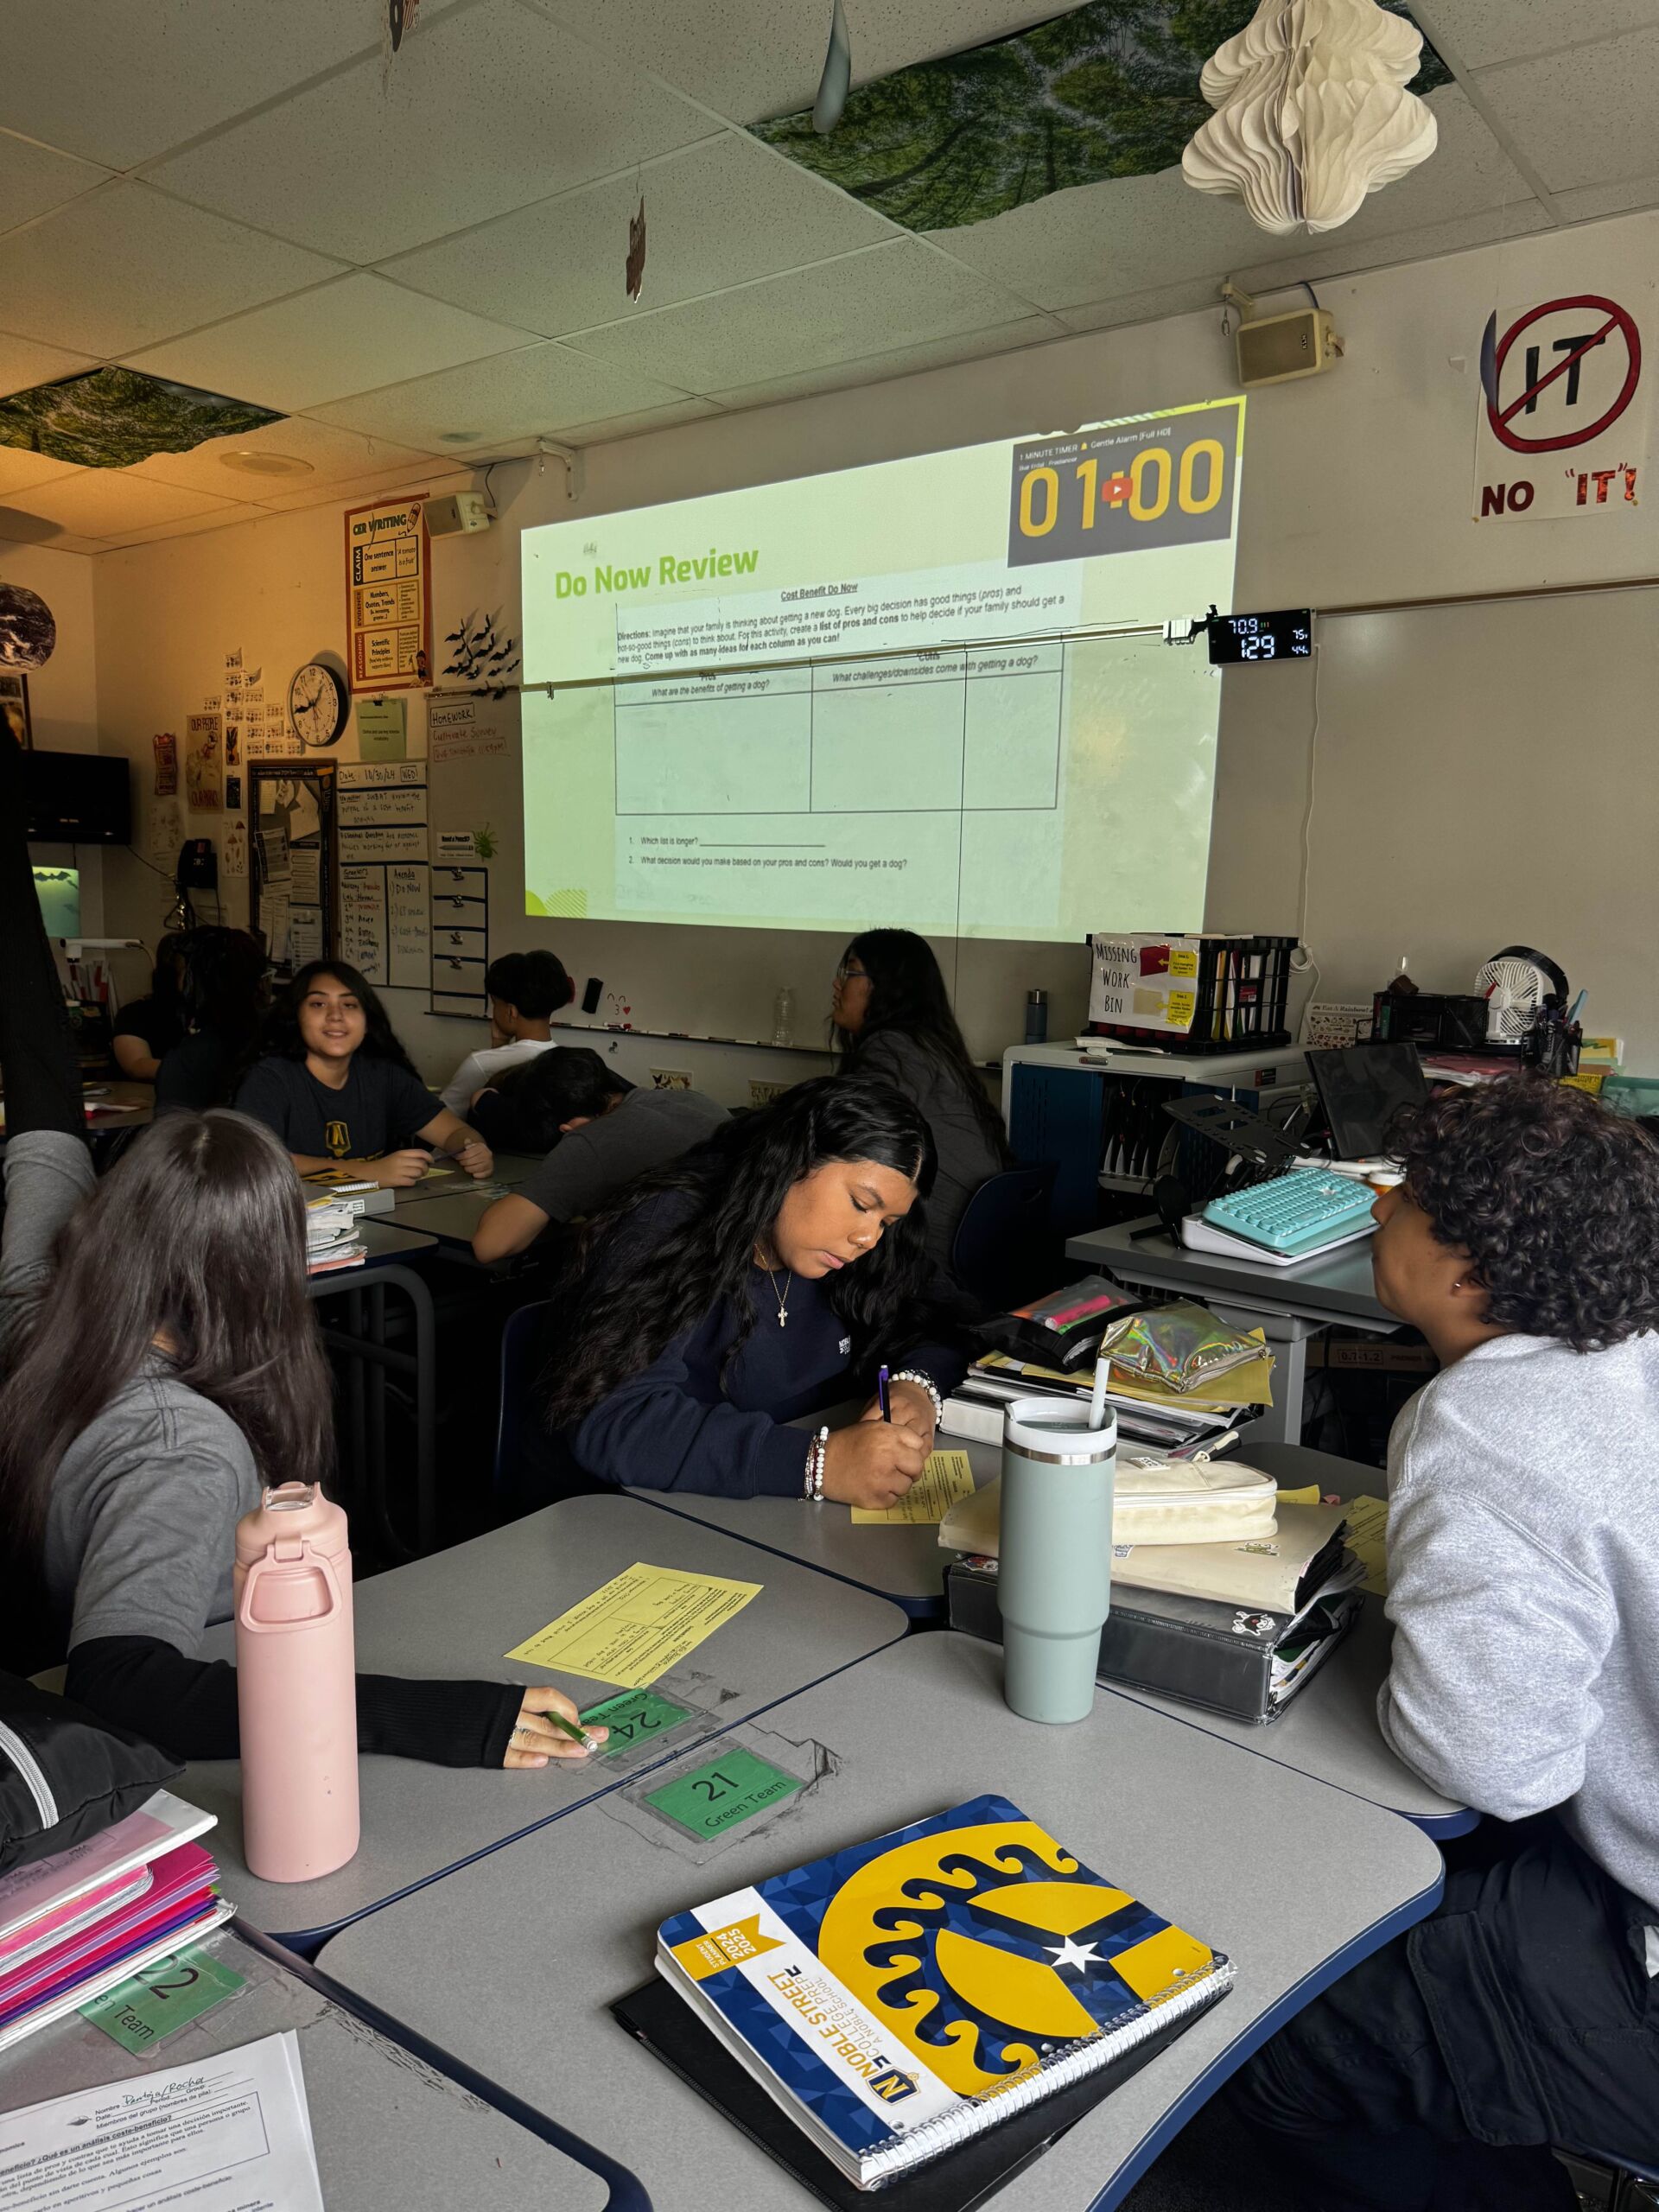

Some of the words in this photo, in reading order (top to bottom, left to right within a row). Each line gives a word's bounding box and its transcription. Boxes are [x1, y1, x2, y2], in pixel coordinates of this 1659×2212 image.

[1525, 334, 1605, 415] IT
[1026, 449, 1053, 461] MINUTE
[1055, 444, 1077, 457] TIMER
[1090, 438, 1114, 449] Gentle
[1116, 434, 1138, 445] Alarm
[1020, 439, 1224, 537] 01:00
[1481, 480, 1535, 517] NO
[368, 514, 407, 532] WRITING
[364, 553, 373, 562] One
[373, 550, 394, 560] sentence
[371, 564, 387, 573] answer
[556, 572, 587, 599] Do
[594, 565, 652, 594] Now
[659, 548, 759, 586] Review
[381, 598, 396, 607] Trends
[781, 590, 798, 601] Cost
[800, 587, 827, 600] Benefit
[840, 582, 858, 594] Now
[617, 631, 651, 641] Directions:
[652, 627, 677, 639] Imagine
[677, 625, 690, 635] that
[691, 625, 704, 636] your
[706, 621, 724, 632] family
[733, 618, 758, 630] thinking
[760, 614, 779, 626] about
[780, 613, 803, 626] getting
[810, 611, 825, 620] new
[845, 606, 866, 618] Every
[880, 600, 912, 612] decision
[930, 594, 950, 608] good
[952, 591, 976, 605] things
[978, 588, 1003, 601] (pros)
[1005, 585, 1021, 597] and
[653, 639, 671, 652] things
[790, 624, 811, 635] create
[842, 618, 861, 632] pros
[879, 614, 899, 625] cons
[928, 607, 955, 620] decide
[984, 600, 1009, 615] family
[1011, 596, 1039, 611] should
[1228, 619, 1258, 634] 70.9
[372, 638, 391, 648] Scientific
[372, 647, 391, 658] Principles
[645, 651, 664, 662] Come
[699, 647, 717, 658] many
[750, 641, 767, 652] each
[768, 638, 795, 649] column
[309, 668, 316, 677] 12
[832, 672, 851, 683] What
[853, 662, 934, 682] challenges/downsides
[936, 663, 957, 674] come
[978, 658, 1006, 672] getting
[1016, 654, 1039, 669] dog?
[329, 683, 334, 691] 2
[652, 688, 668, 697] What
[691, 683, 715, 695] benefits
[753, 679, 771, 691] dog?
[333, 698, 338, 707] 3
[298, 720, 302, 729] 8
[641, 836, 659, 846] Which
[677, 836, 699, 848] longer?
[732, 857, 752, 867] based
[809, 857, 830, 867] cons?
[830, 859, 853, 868] Would
[888, 858, 908, 870] dog?
[1096, 944, 1137, 963] MISSING
[1103, 969, 1130, 988] WORK
[1104, 995, 1122, 1014] BIN
[1341, 1351, 1381, 1362] 0.7-1.2
[613, 1692, 648, 1712] Green
[582, 1710, 611, 1726] Tea
[612, 1711, 662, 1739] 24
[691, 1771, 741, 1802] 21
[705, 1798, 748, 1828] Green
[744, 1781, 787, 1804] Team
[702, 1939, 728, 1967] PLANNER
[716, 1931, 744, 1961] 2024
[728, 1928, 758, 1955] 2025
[695, 1942, 721, 1969] STUDENT
[766, 1971, 828, 2026] STREET
[794, 1975, 829, 2007] PREP
[815, 1976, 849, 2009] SCHOOL
[114, 2004, 156, 2041] Team
[822, 2001, 880, 2059] COLLEGE
[818, 2023, 880, 2079] NOBLE
[873, 2037, 884, 2046] A
[871, 2074, 910, 2101] N
[95, 2103, 120, 2116] Nombre
[96, 2116, 128, 2130] Miembros
[129, 2111, 139, 2121] del
[140, 2107, 158, 2118] grupo
[159, 2097, 188, 2113] (nombres
[68, 2153, 94, 2164] contras
[118, 2137, 140, 2148] ayuda
[146, 2127, 167, 2138] tomar
[182, 2113, 211, 2126] decisión
[82, 2134, 111, 2149] análisis
[111, 2114, 173, 2139] coste-beneficio?
[138, 2134, 169, 2148] significa
[198, 2115, 224, 2128] persona
[231, 2106, 251, 2118] grupo
[20, 2174, 67, 2193] dependiendo
[131, 2139, 170, 2157] importante
[140, 2152, 172, 2166] ejemplos
